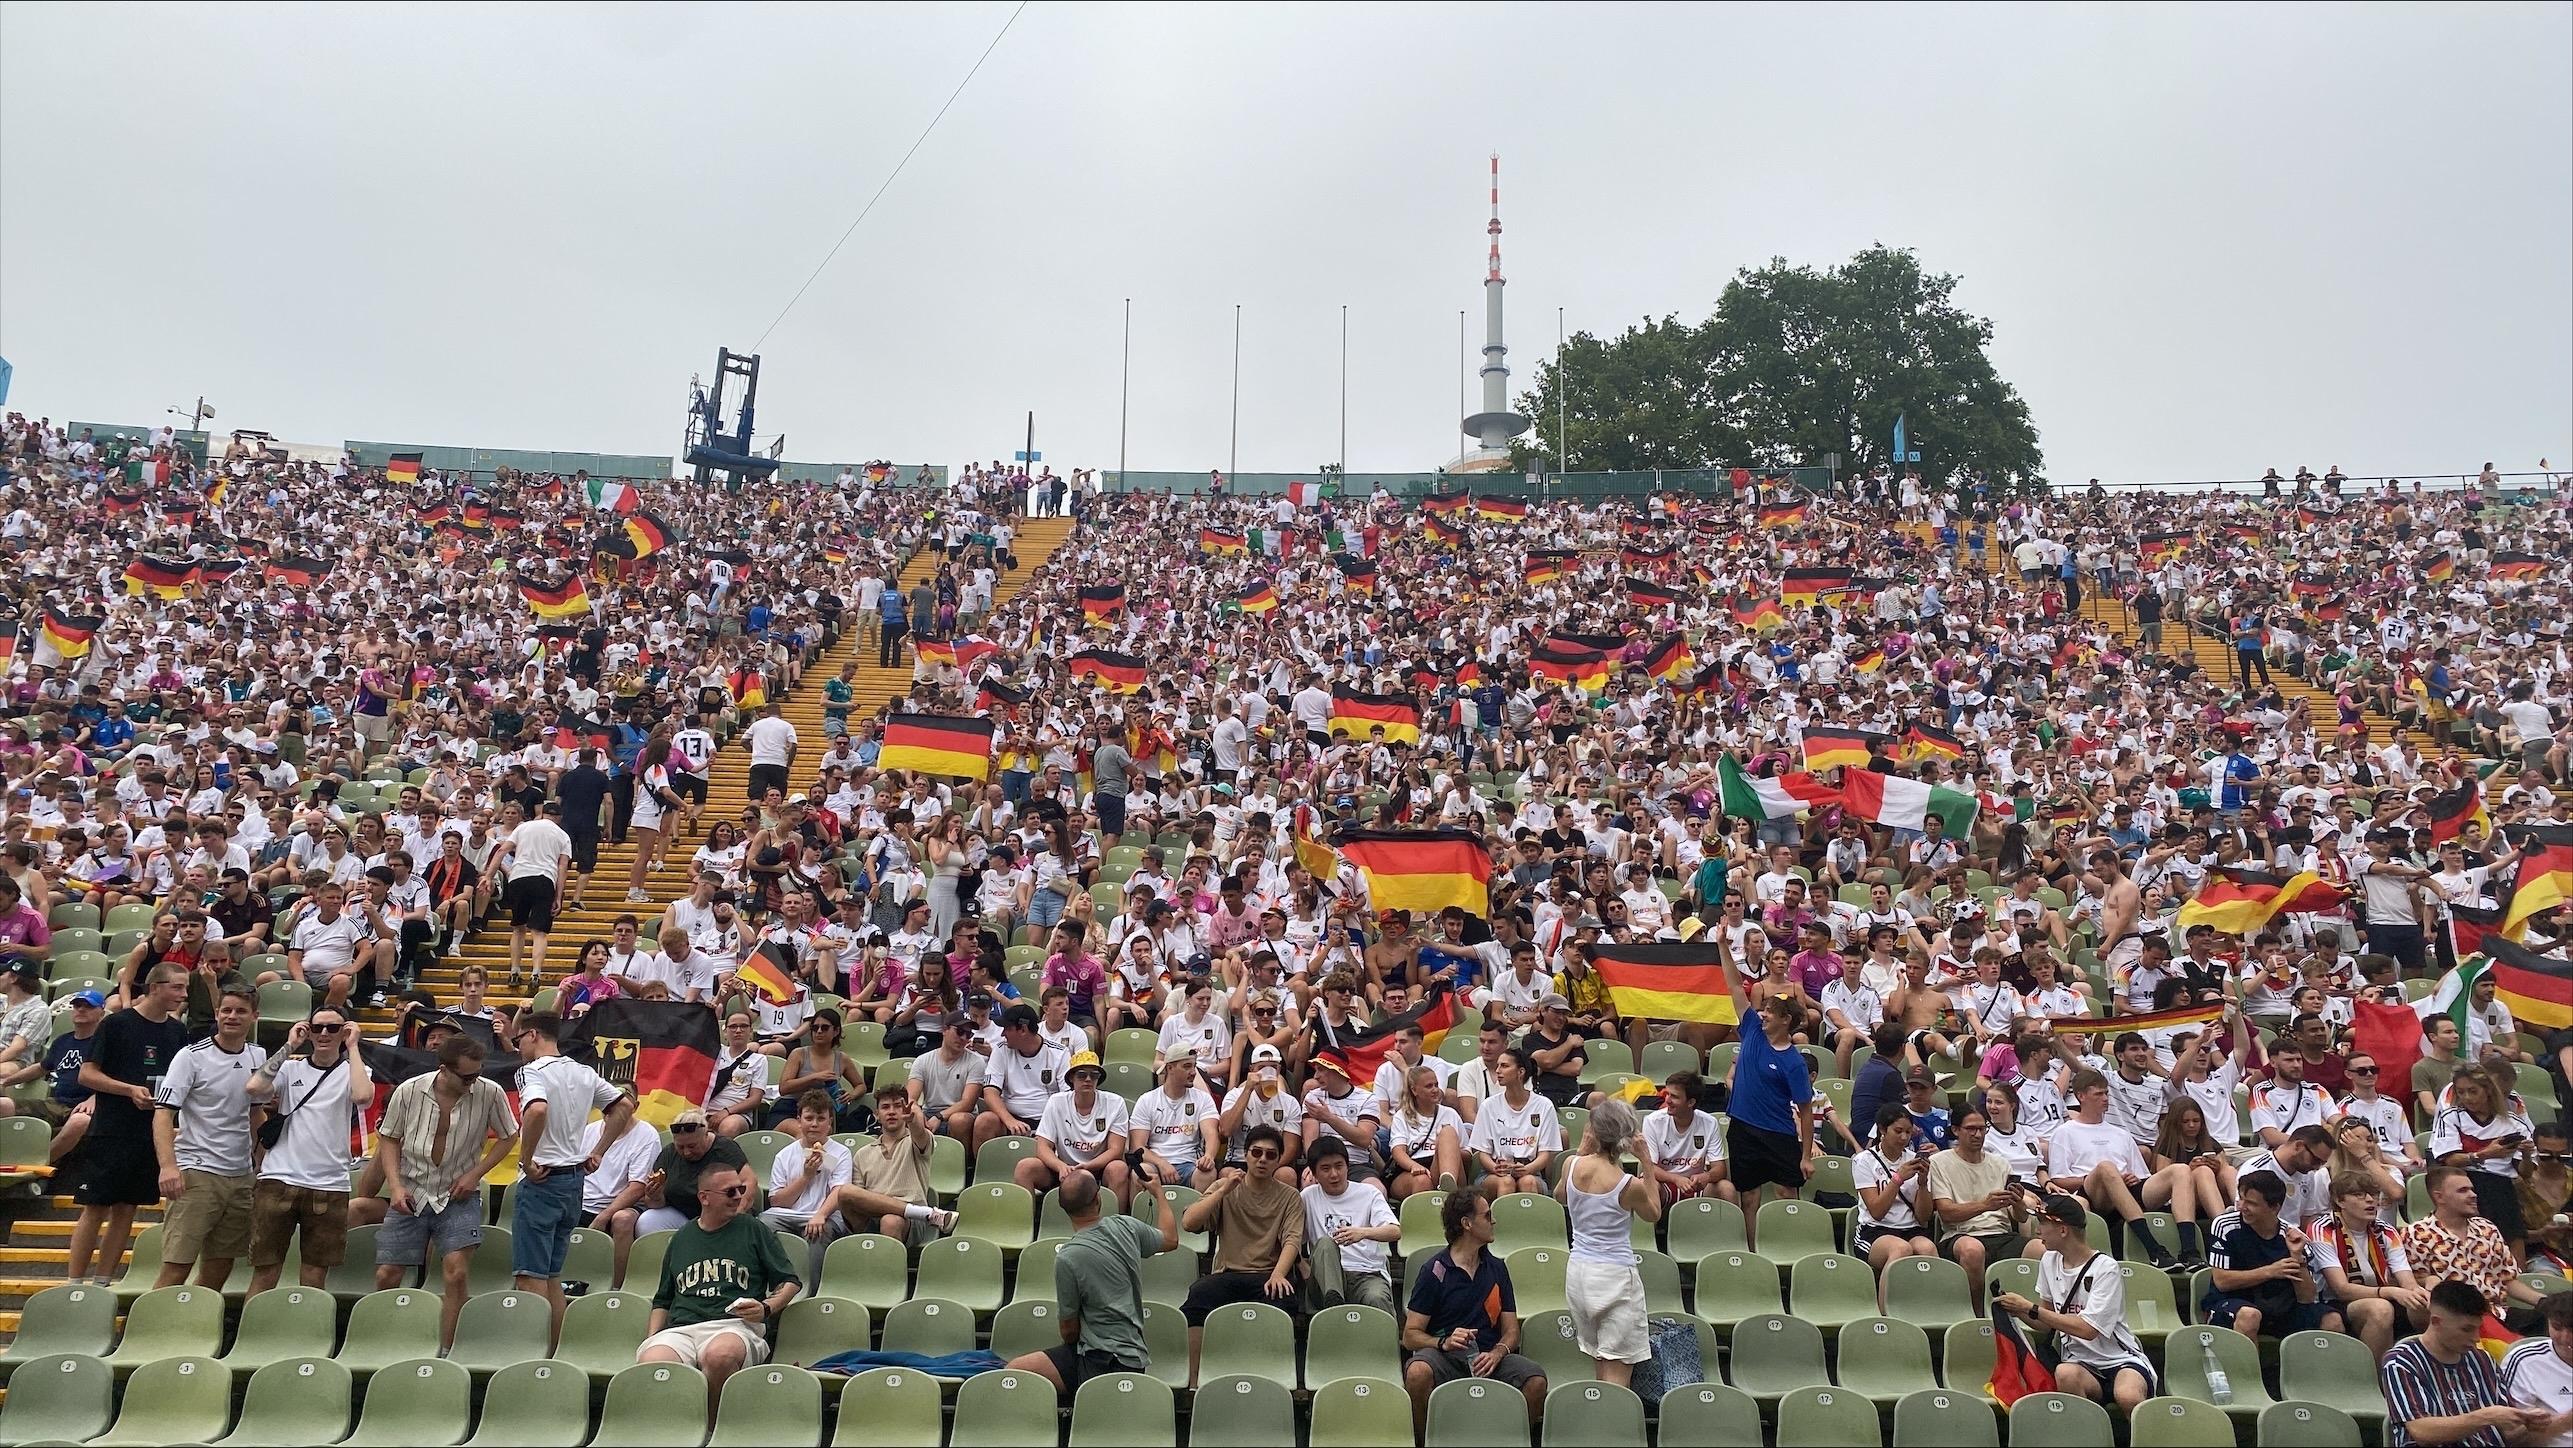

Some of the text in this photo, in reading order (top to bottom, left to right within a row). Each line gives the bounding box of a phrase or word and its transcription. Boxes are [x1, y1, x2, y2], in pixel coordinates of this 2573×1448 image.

[680, 737, 702, 757] 13
[1065, 978, 1079, 994] 10
[773, 1011, 785, 1025] 19
[2043, 1103, 2061, 1121] 19
[2132, 1103, 2143, 1119] 7
